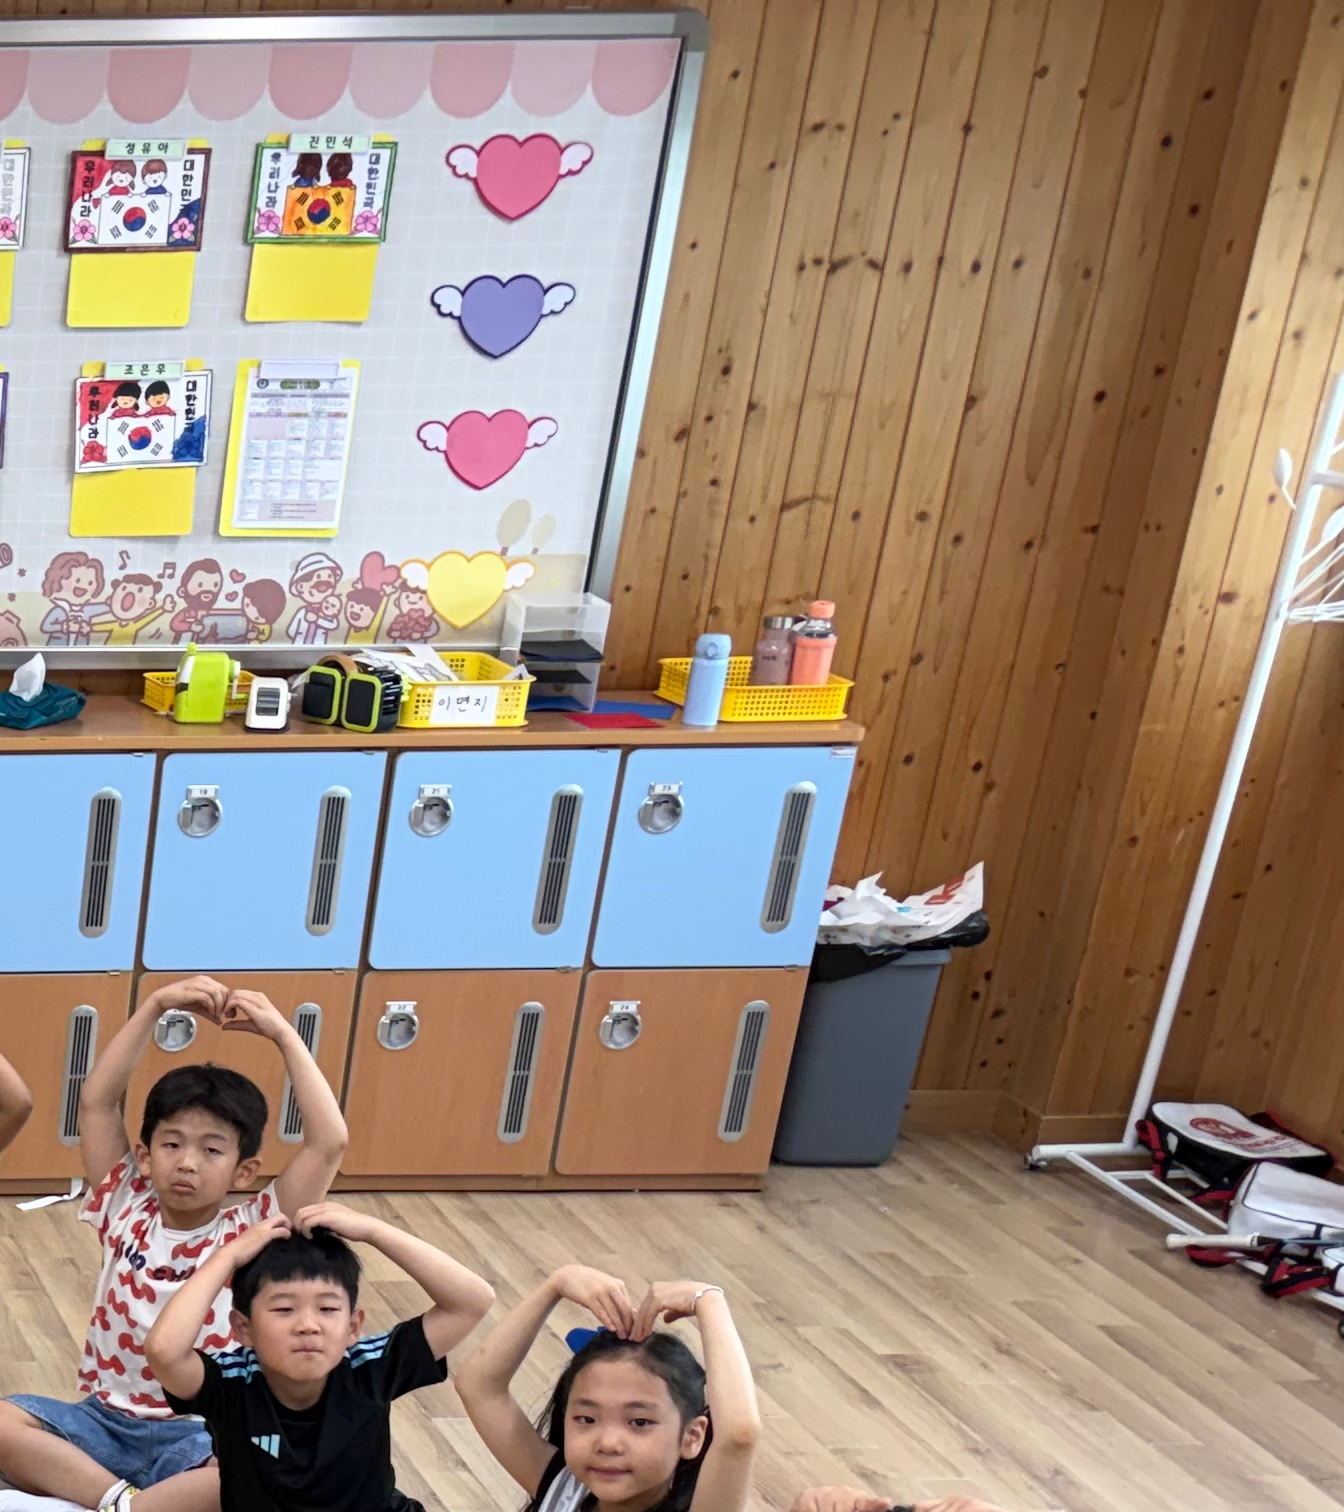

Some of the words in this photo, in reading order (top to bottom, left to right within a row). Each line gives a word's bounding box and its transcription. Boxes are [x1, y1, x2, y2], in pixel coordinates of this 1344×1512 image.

[310, 136, 353, 149] 진민석
[79, 159, 96, 218] 우리나라
[123, 364, 166, 376] 조은우
[438, 697, 487, 713] 이면지
